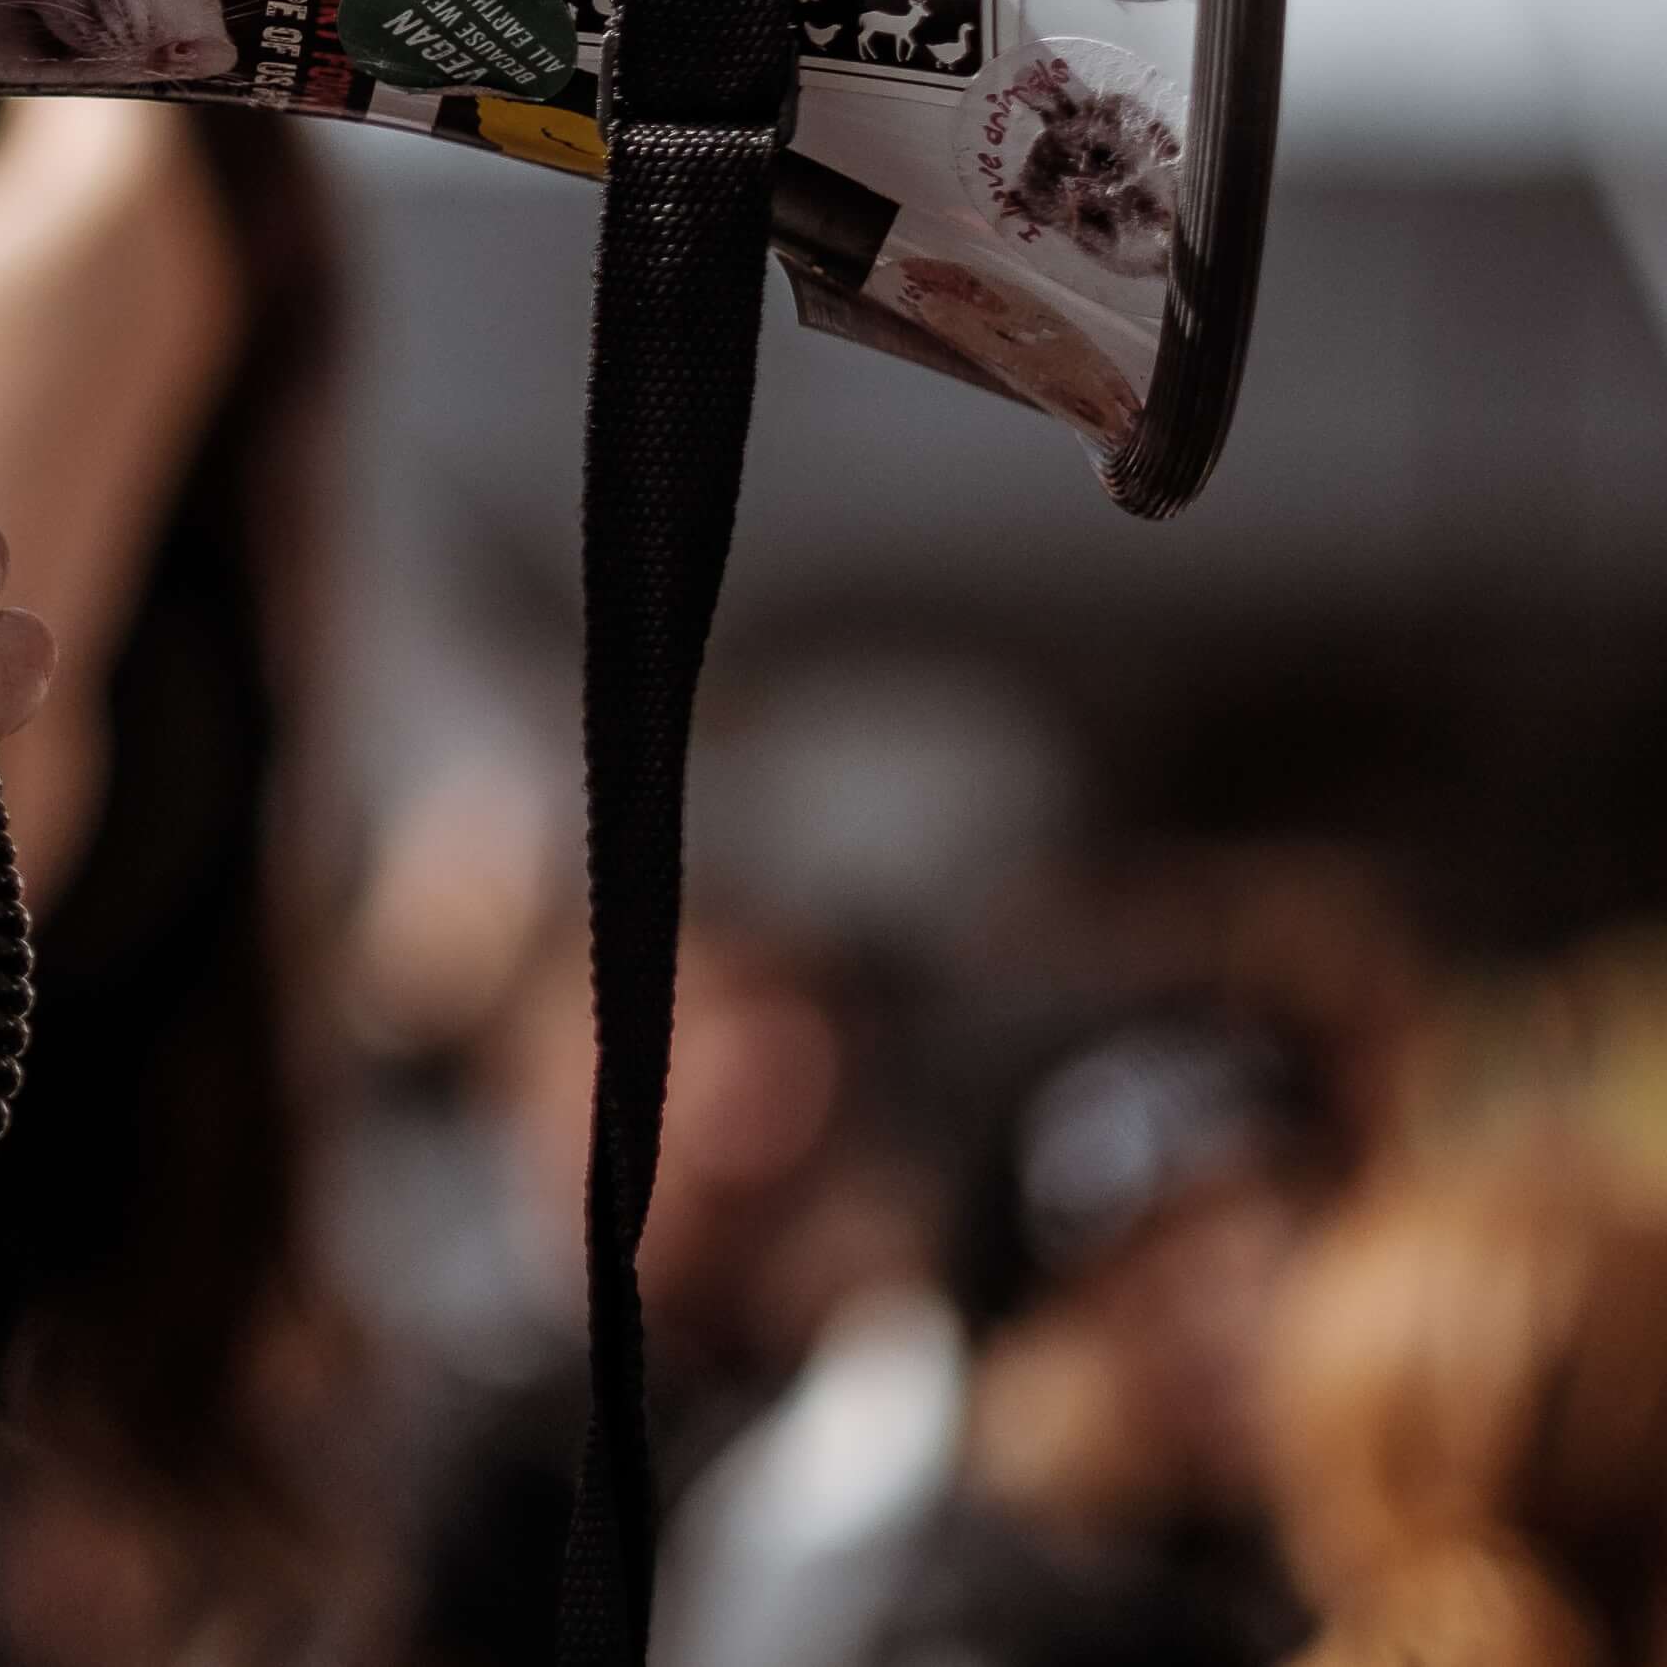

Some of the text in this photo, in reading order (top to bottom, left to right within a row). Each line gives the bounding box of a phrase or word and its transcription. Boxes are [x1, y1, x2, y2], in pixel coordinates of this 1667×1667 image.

[260, 25, 304, 58] OF
[381, 7, 490, 82] VEGAN
[454, 21, 538, 85] BECAUSE
[527, 44, 566, 74] ALL
